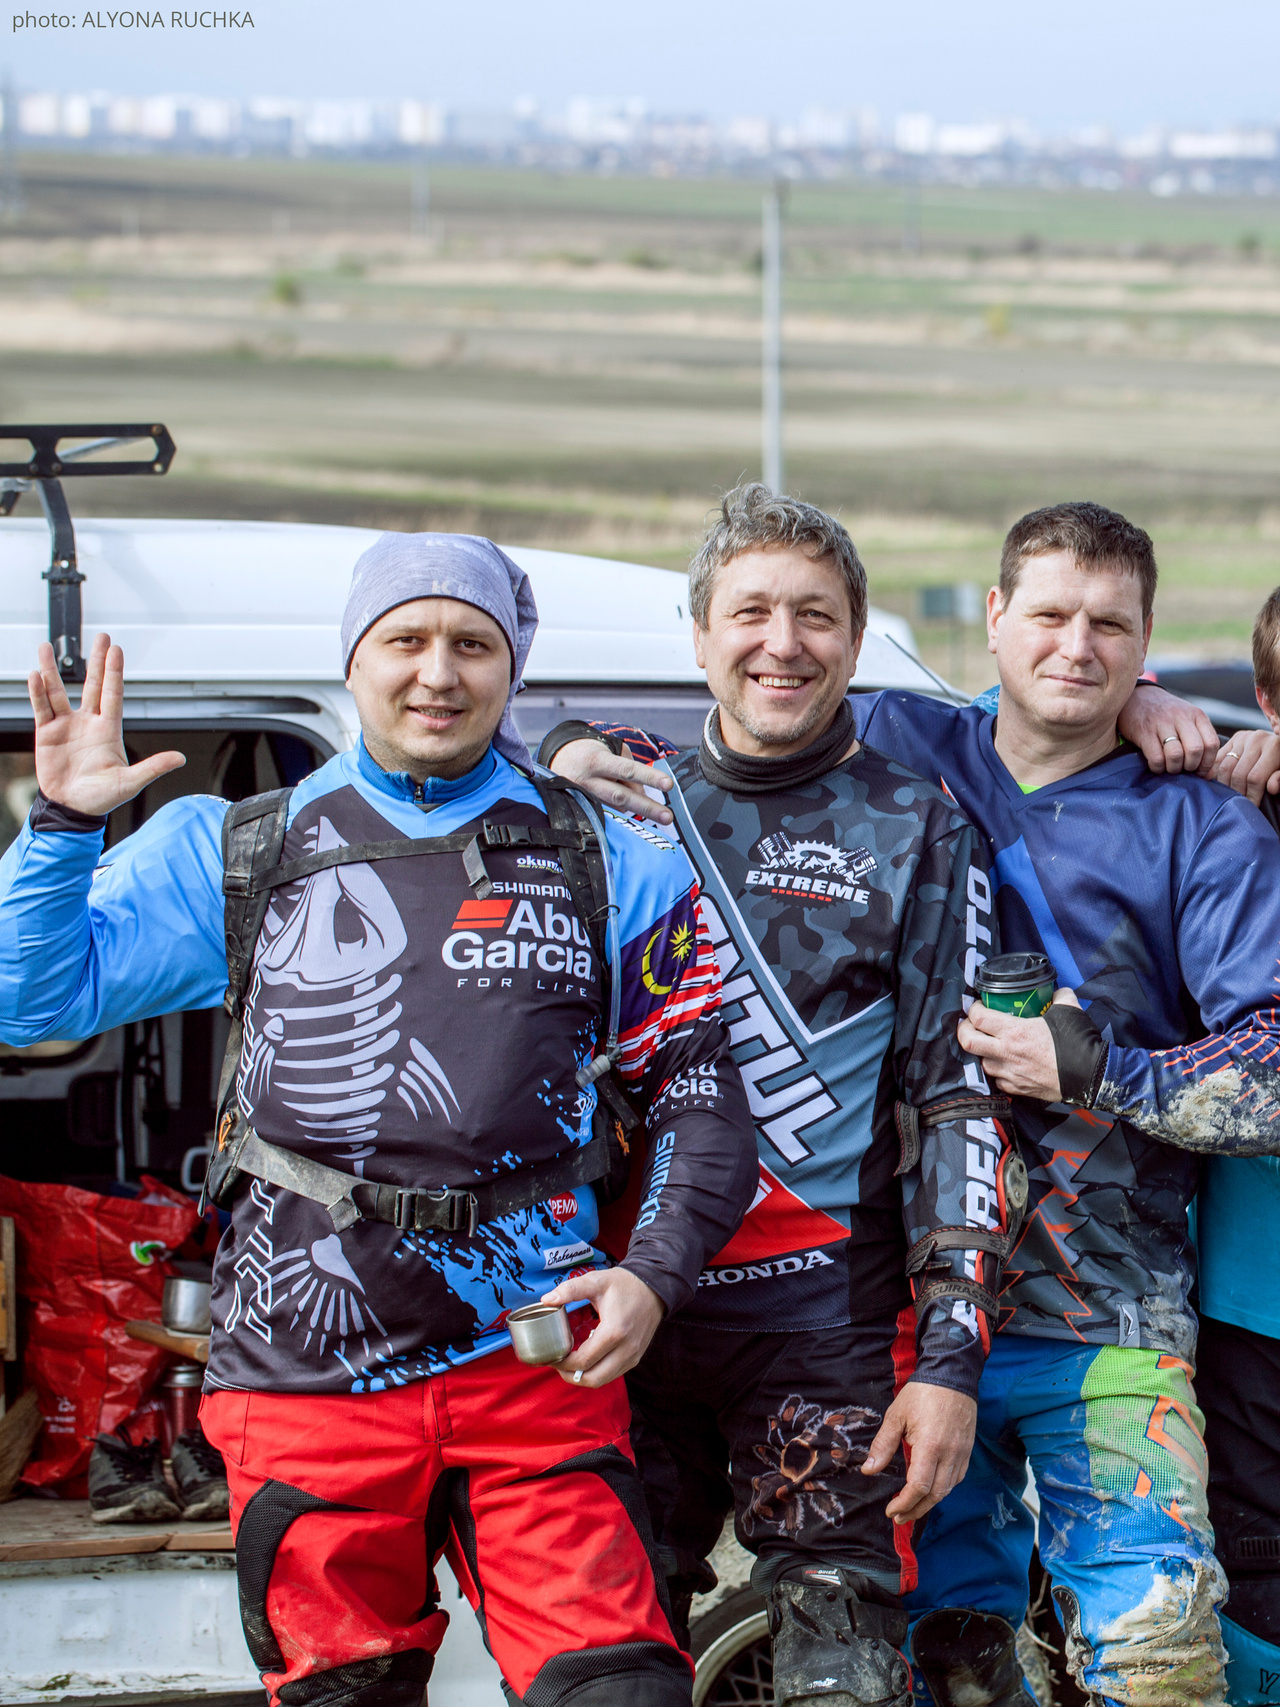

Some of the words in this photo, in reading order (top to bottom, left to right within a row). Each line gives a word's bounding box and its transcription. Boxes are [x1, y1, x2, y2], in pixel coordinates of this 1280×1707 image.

[745, 870, 870, 905] EXTREME
[505, 900, 591, 948] Abu
[441, 931, 592, 982] Garcia
[457, 977, 513, 989] FOR
[537, 979, 588, 998] LIFE
[670, 1099, 715, 1110] LIFE
[551, 1198, 578, 1216] PENN
[697, 1249, 835, 1287] HONDA
[932, 1284, 998, 1310] CUIRASSIER
